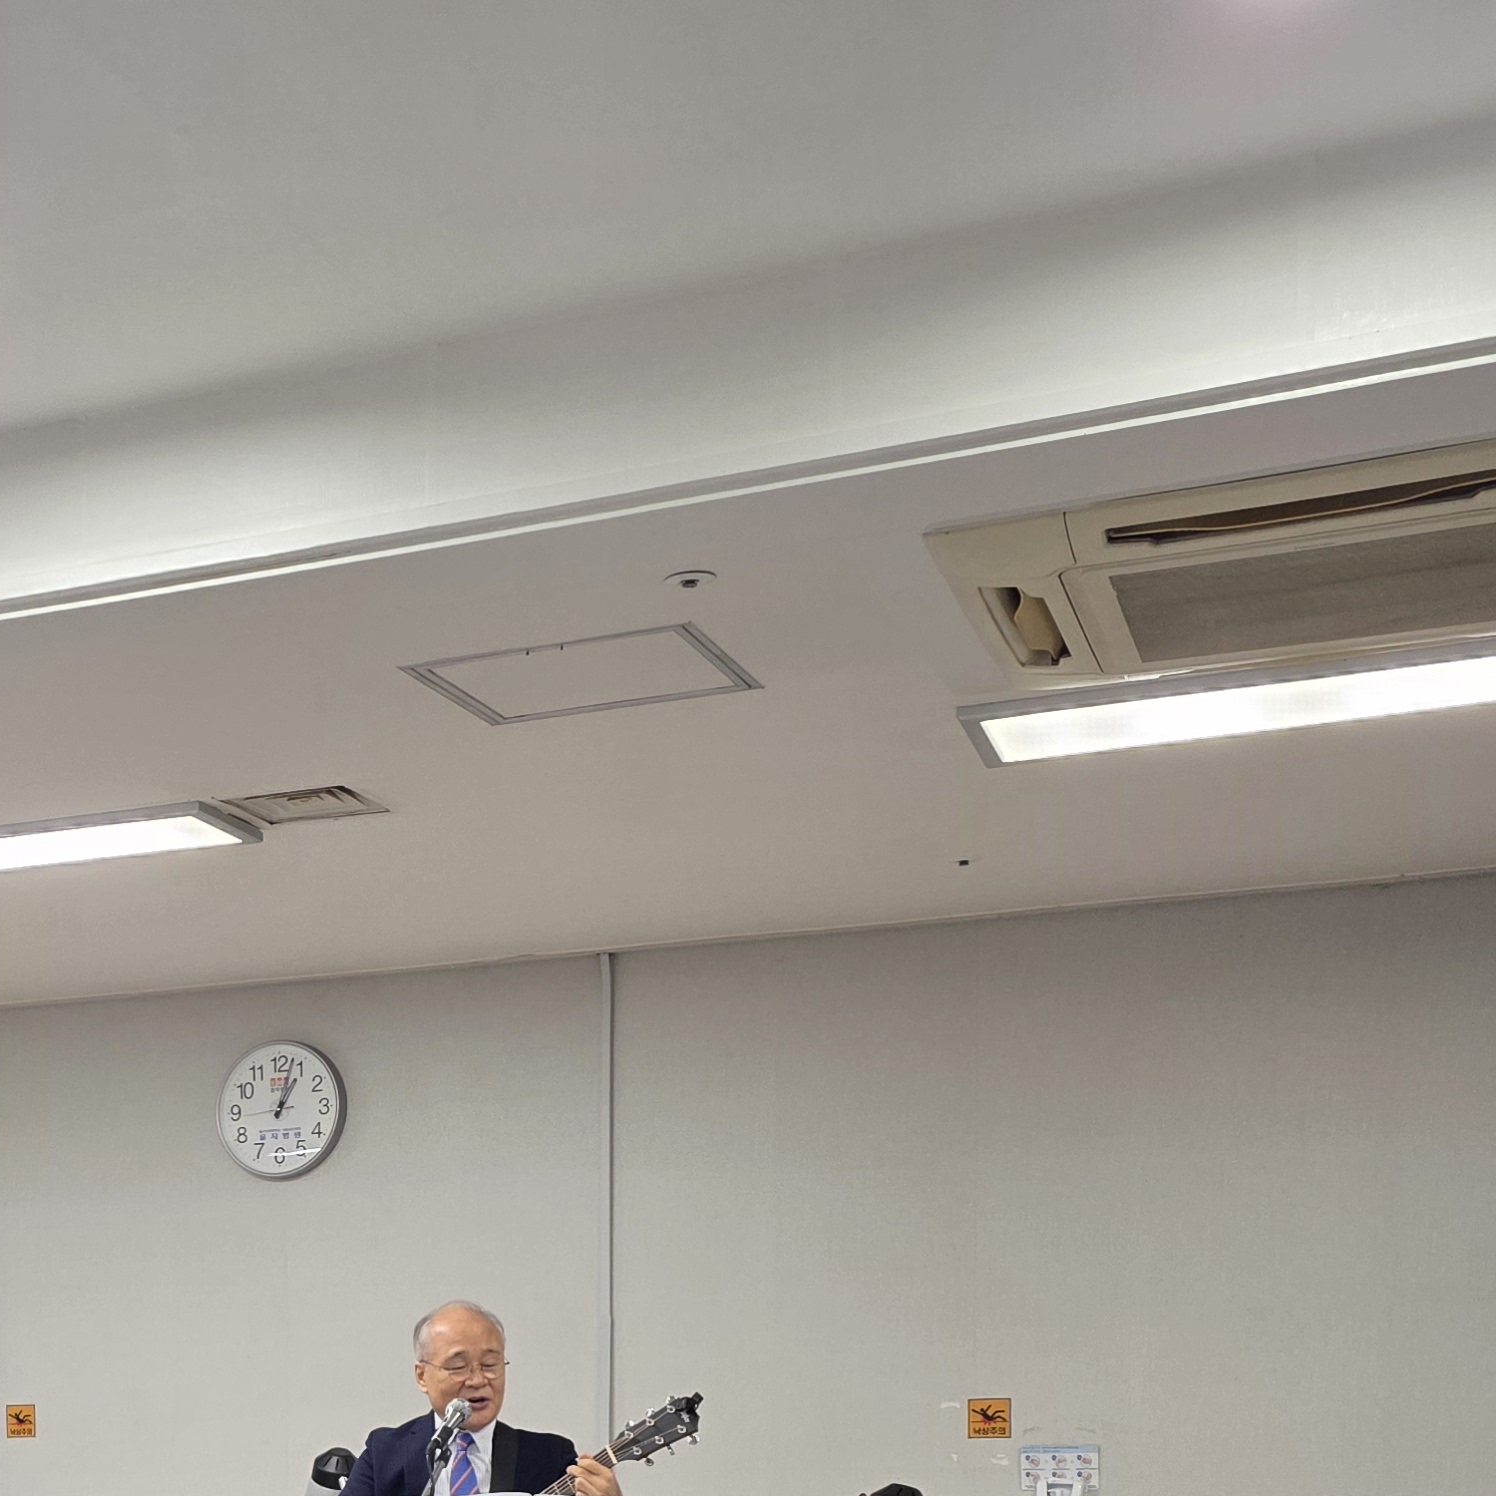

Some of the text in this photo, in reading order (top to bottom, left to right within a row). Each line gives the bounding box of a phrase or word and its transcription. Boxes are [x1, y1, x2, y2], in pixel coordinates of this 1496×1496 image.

[270, 1055, 289, 1073] 12
[297, 1061, 303, 1077] 1
[249, 1065, 264, 1081] 11
[237, 1082, 255, 1100] 10
[312, 1075, 323, 1092] 2
[230, 1104, 242, 1121] 9
[318, 1098, 330, 1115] 3
[236, 1127, 248, 1143] 8
[311, 1122, 323, 1138] 4
[254, 1143, 265, 1159] 7
[295, 1140, 307, 1156] 5
[973, 1427, 1006, 1436] 낙상주의
